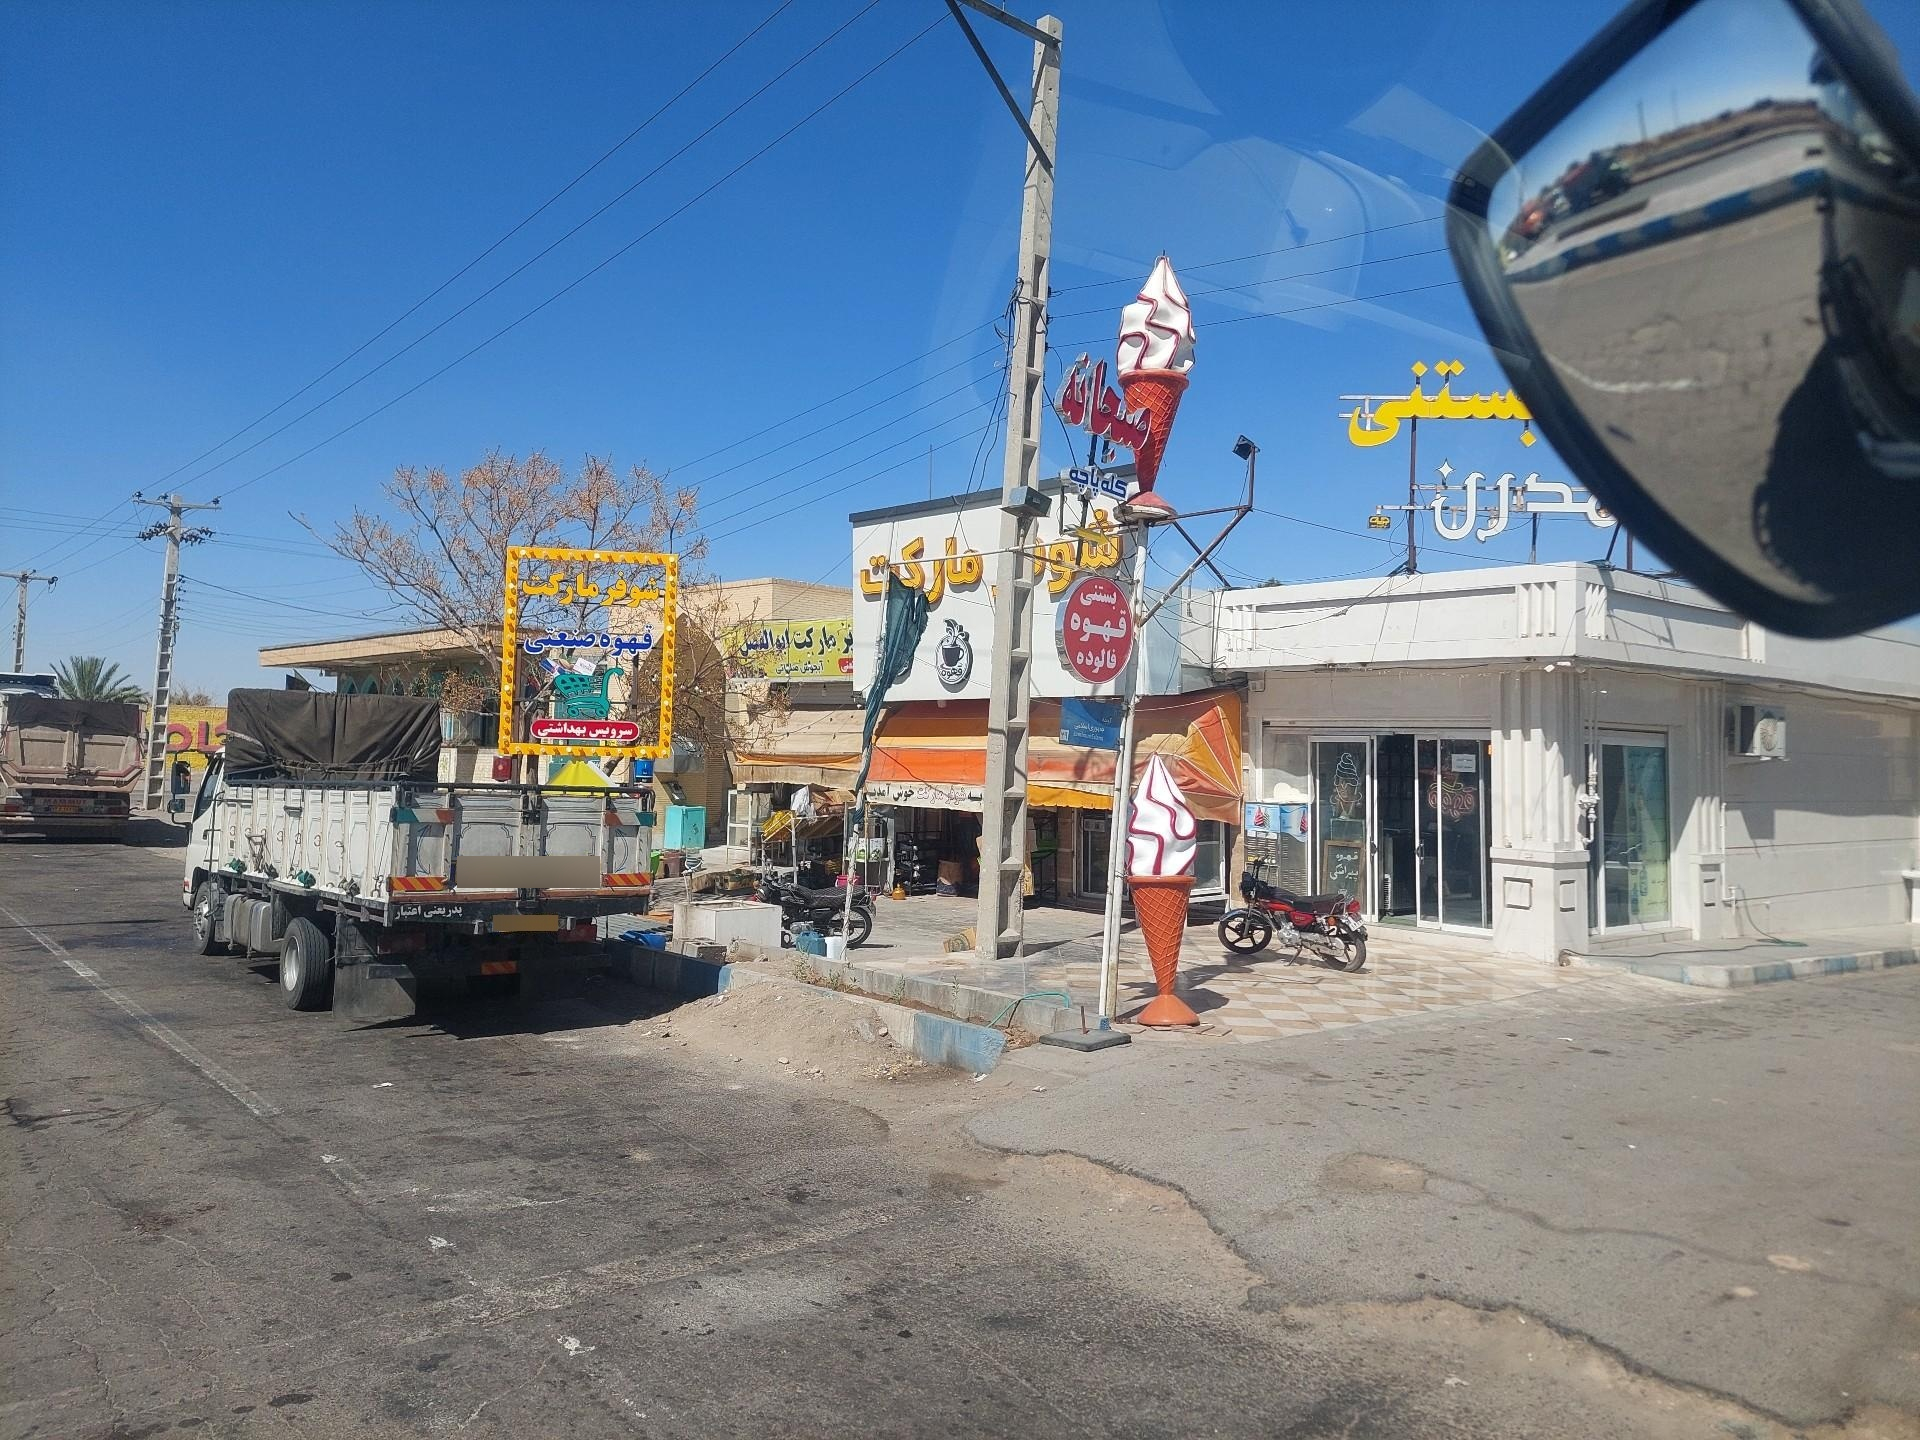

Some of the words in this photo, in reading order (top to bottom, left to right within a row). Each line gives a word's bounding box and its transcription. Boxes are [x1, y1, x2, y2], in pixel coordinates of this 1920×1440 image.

[1069, 467, 1100, 497] پاچه
[1101, 474, 1128, 499] کله
[859, 536, 984, 604] مارکت
[521, 572, 600, 605] مارکت
[600, 571, 660, 608] شوفر
[1080, 584, 1118, 610] بستنی
[1070, 609, 1127, 643] قهوه
[524, 625, 597, 655] صنعتی
[599, 625, 655, 657] قهوه
[793, 625, 837, 656] مارکت
[941, 664, 964, 680] قهوه
[1076, 647, 1117, 674] فالوده
[536, 722, 587, 738] بهداشتی
[588, 726, 634, 740] سرویس
[43, 798, 88, 806] MAMMUT
[866, 782, 891, 799] آمدی
[892, 785, 915, 802] خوش
[1335, 851, 1359, 862] قهوه
[394, 904, 422, 920] اعتبار
[423, 905, 446, 918] یعنی
[445, 905, 463, 918] پدر
